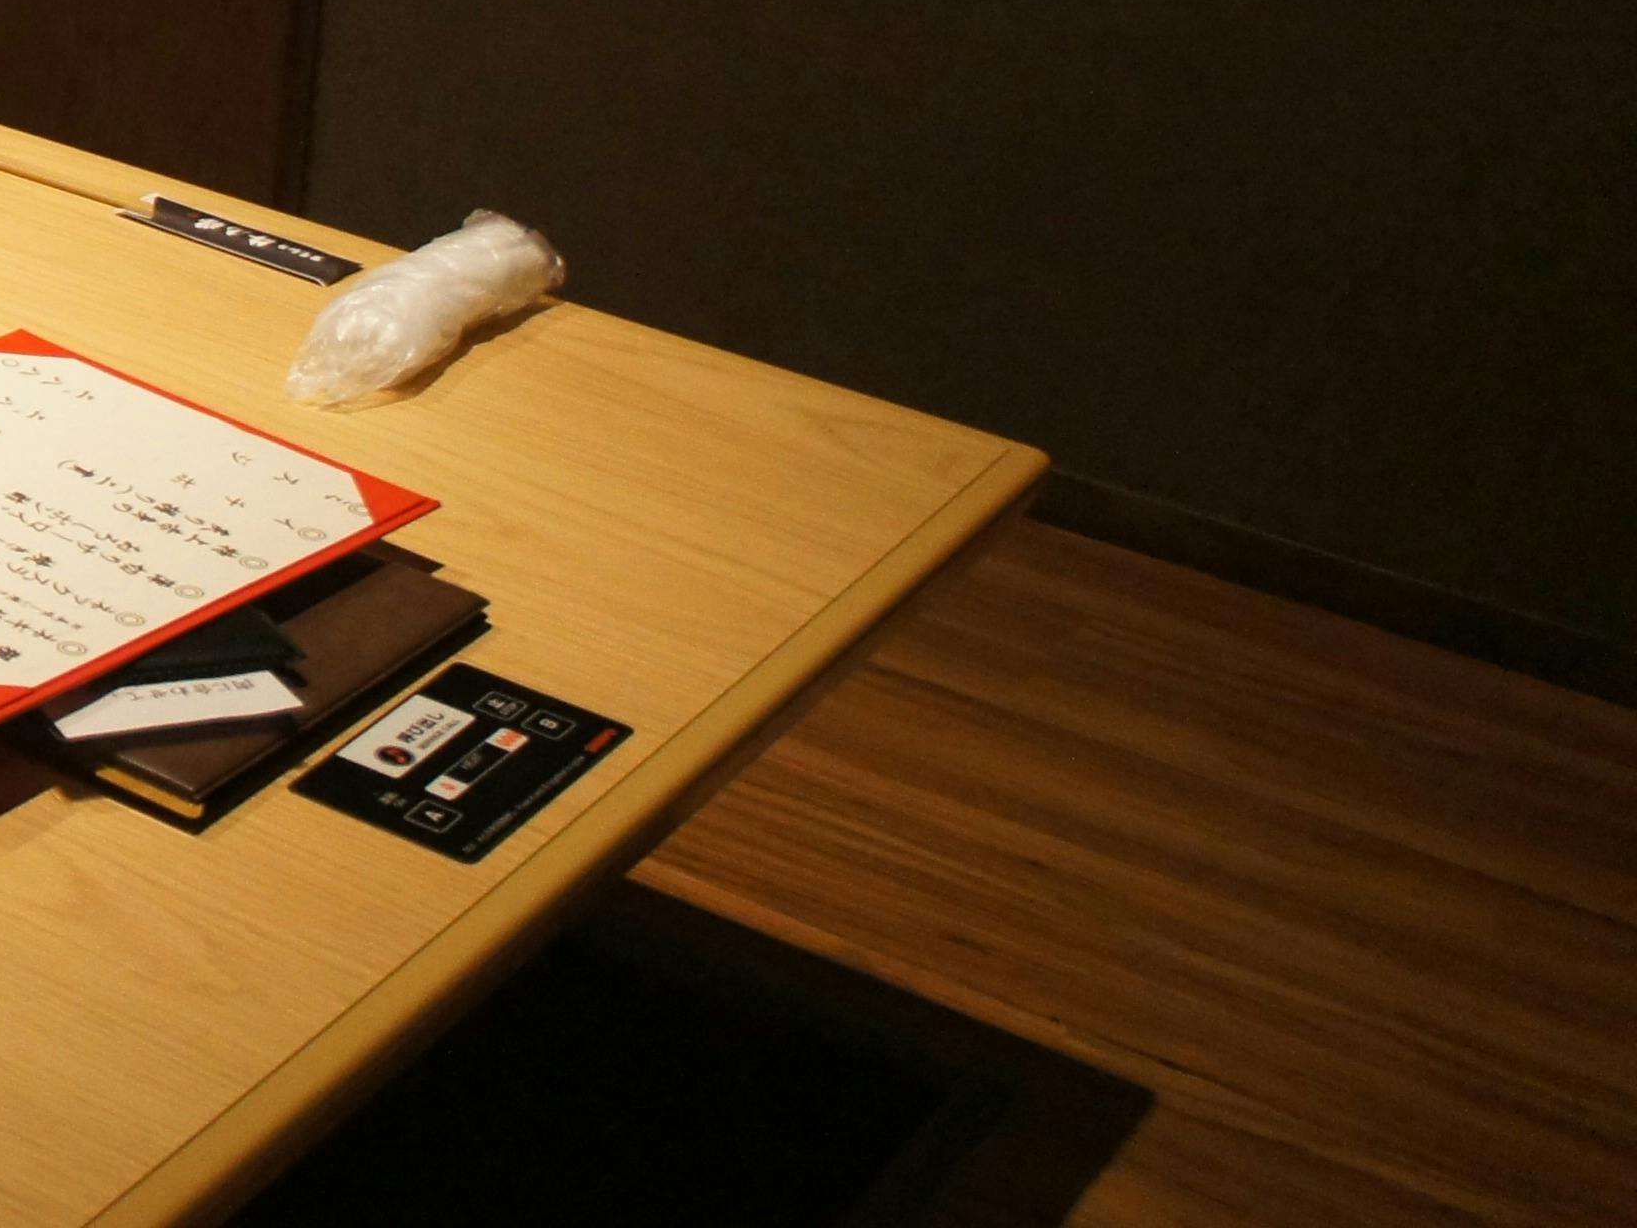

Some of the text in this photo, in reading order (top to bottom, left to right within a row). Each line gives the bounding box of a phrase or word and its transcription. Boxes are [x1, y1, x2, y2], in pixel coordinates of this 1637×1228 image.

[232, 452, 351, 506] ミスジ
[396, 712, 445, 744] 呼び出し
